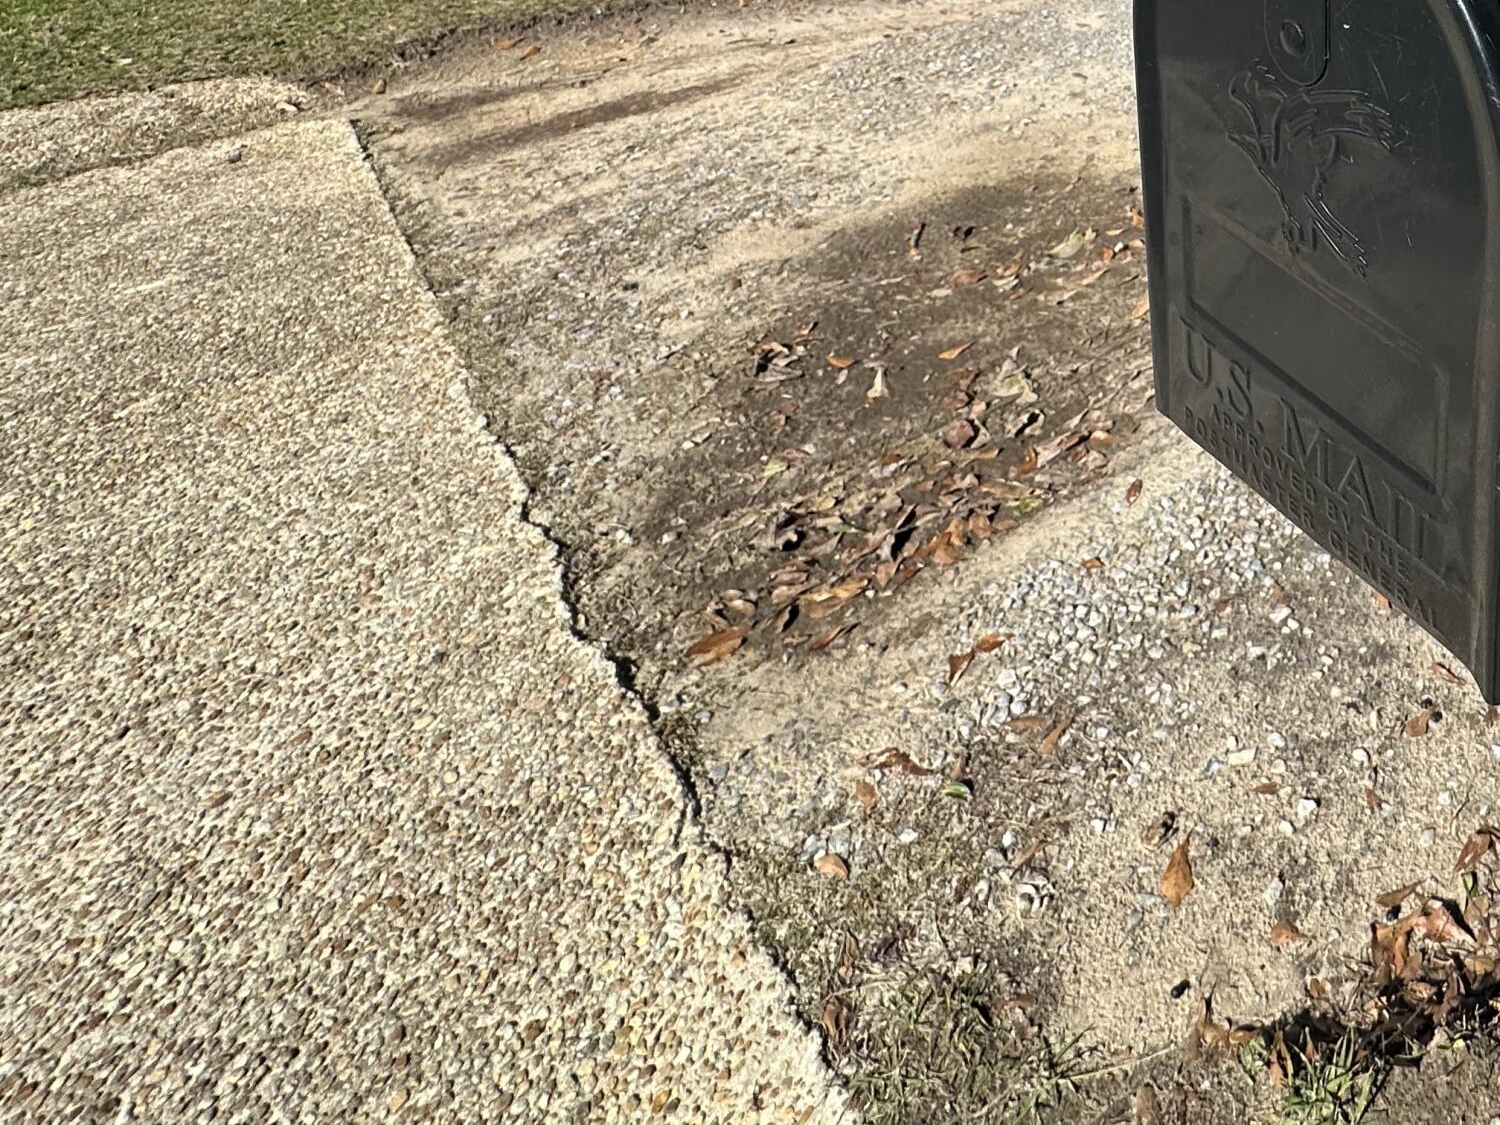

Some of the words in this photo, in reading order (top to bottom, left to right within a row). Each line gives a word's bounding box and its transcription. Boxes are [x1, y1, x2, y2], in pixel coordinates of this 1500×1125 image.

[1179, 315, 1265, 433] U.S.
[1279, 396, 1447, 585] MAIL
[1184, 405, 1315, 532] POSTMASTER
[1328, 530, 1443, 635] GENERAL
[1211, 404, 1316, 505] APPROVED
[1326, 499, 1354, 534] BY
[1362, 528, 1410, 582] THE
